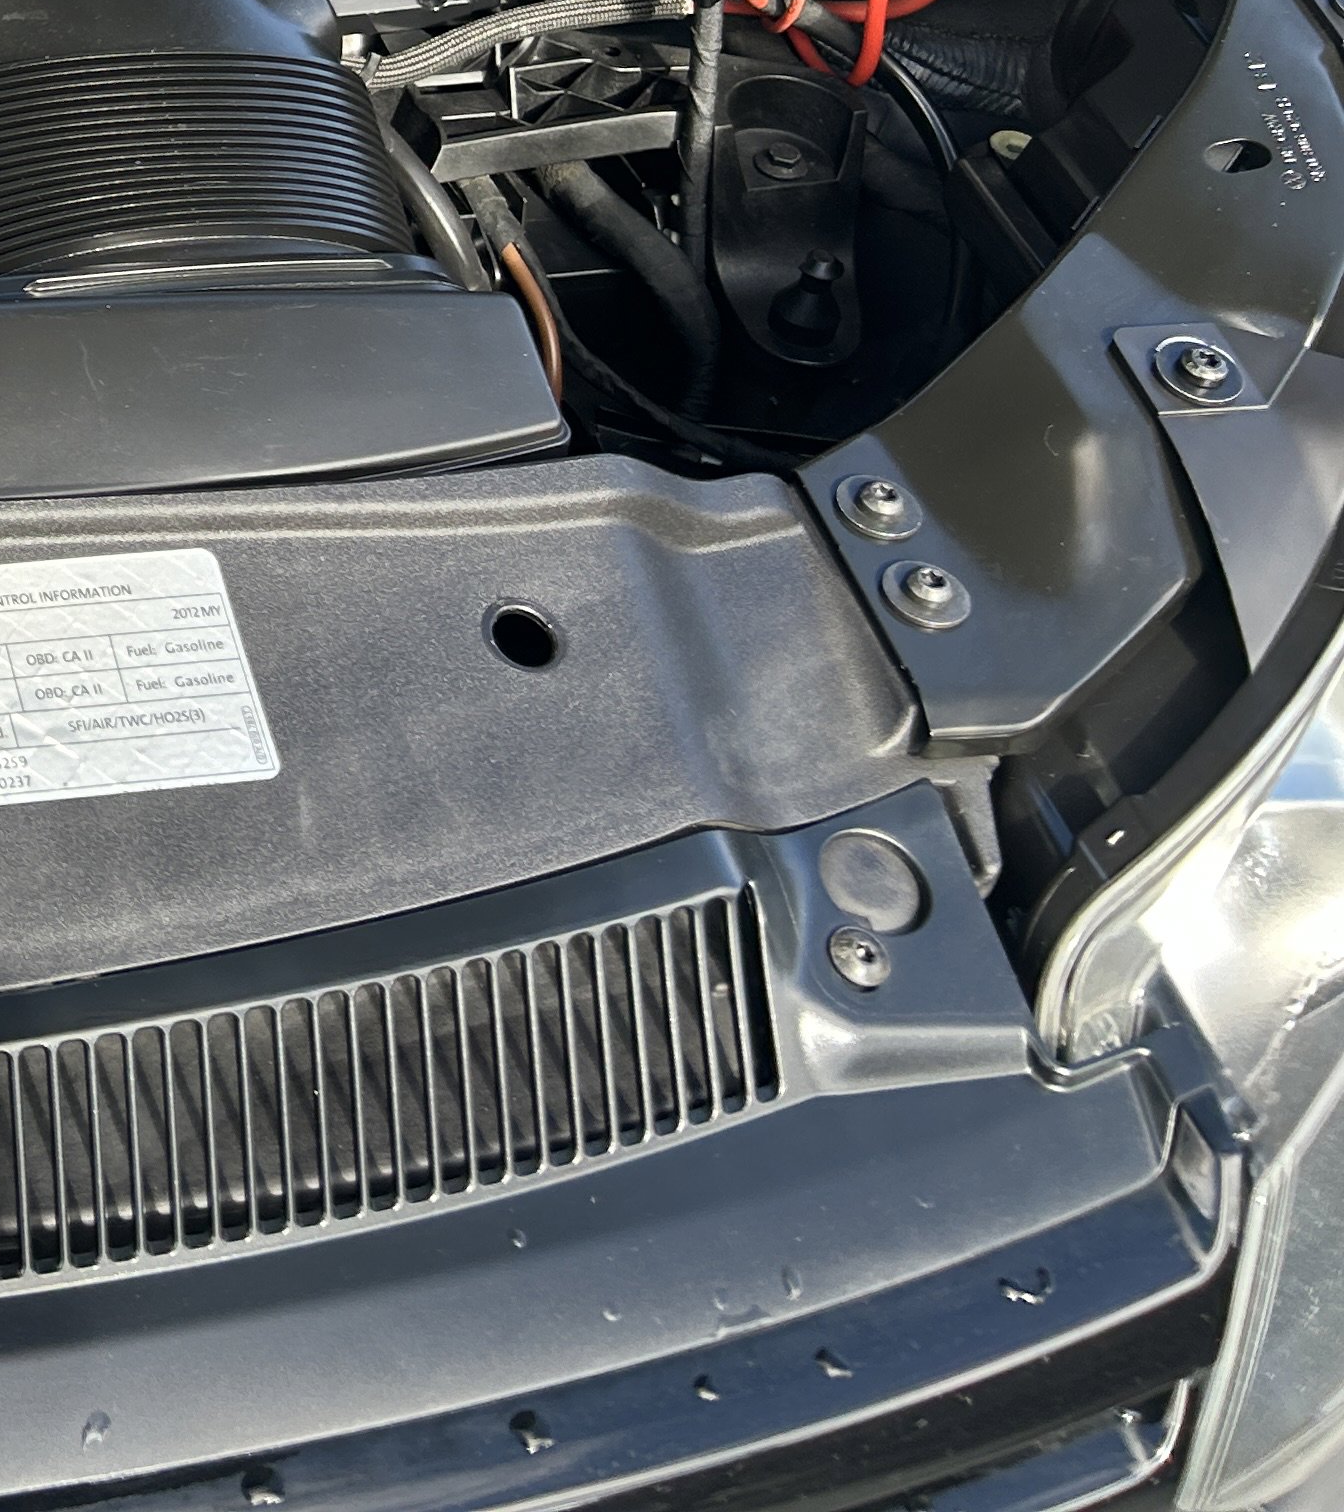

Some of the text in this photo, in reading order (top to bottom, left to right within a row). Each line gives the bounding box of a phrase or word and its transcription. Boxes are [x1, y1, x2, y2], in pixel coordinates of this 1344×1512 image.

[38, 583, 132, 602] INFORMATION
[170, 604, 222, 619] 2012 MY
[125, 637, 225, 657] Fuel: Gasoline
[25, 652, 58, 666] OBD:
[61, 650, 81, 662] CA
[135, 671, 235, 691] Fuel: Gasoline
[34, 686, 67, 700] OBD:
[70, 684, 90, 697] CA
